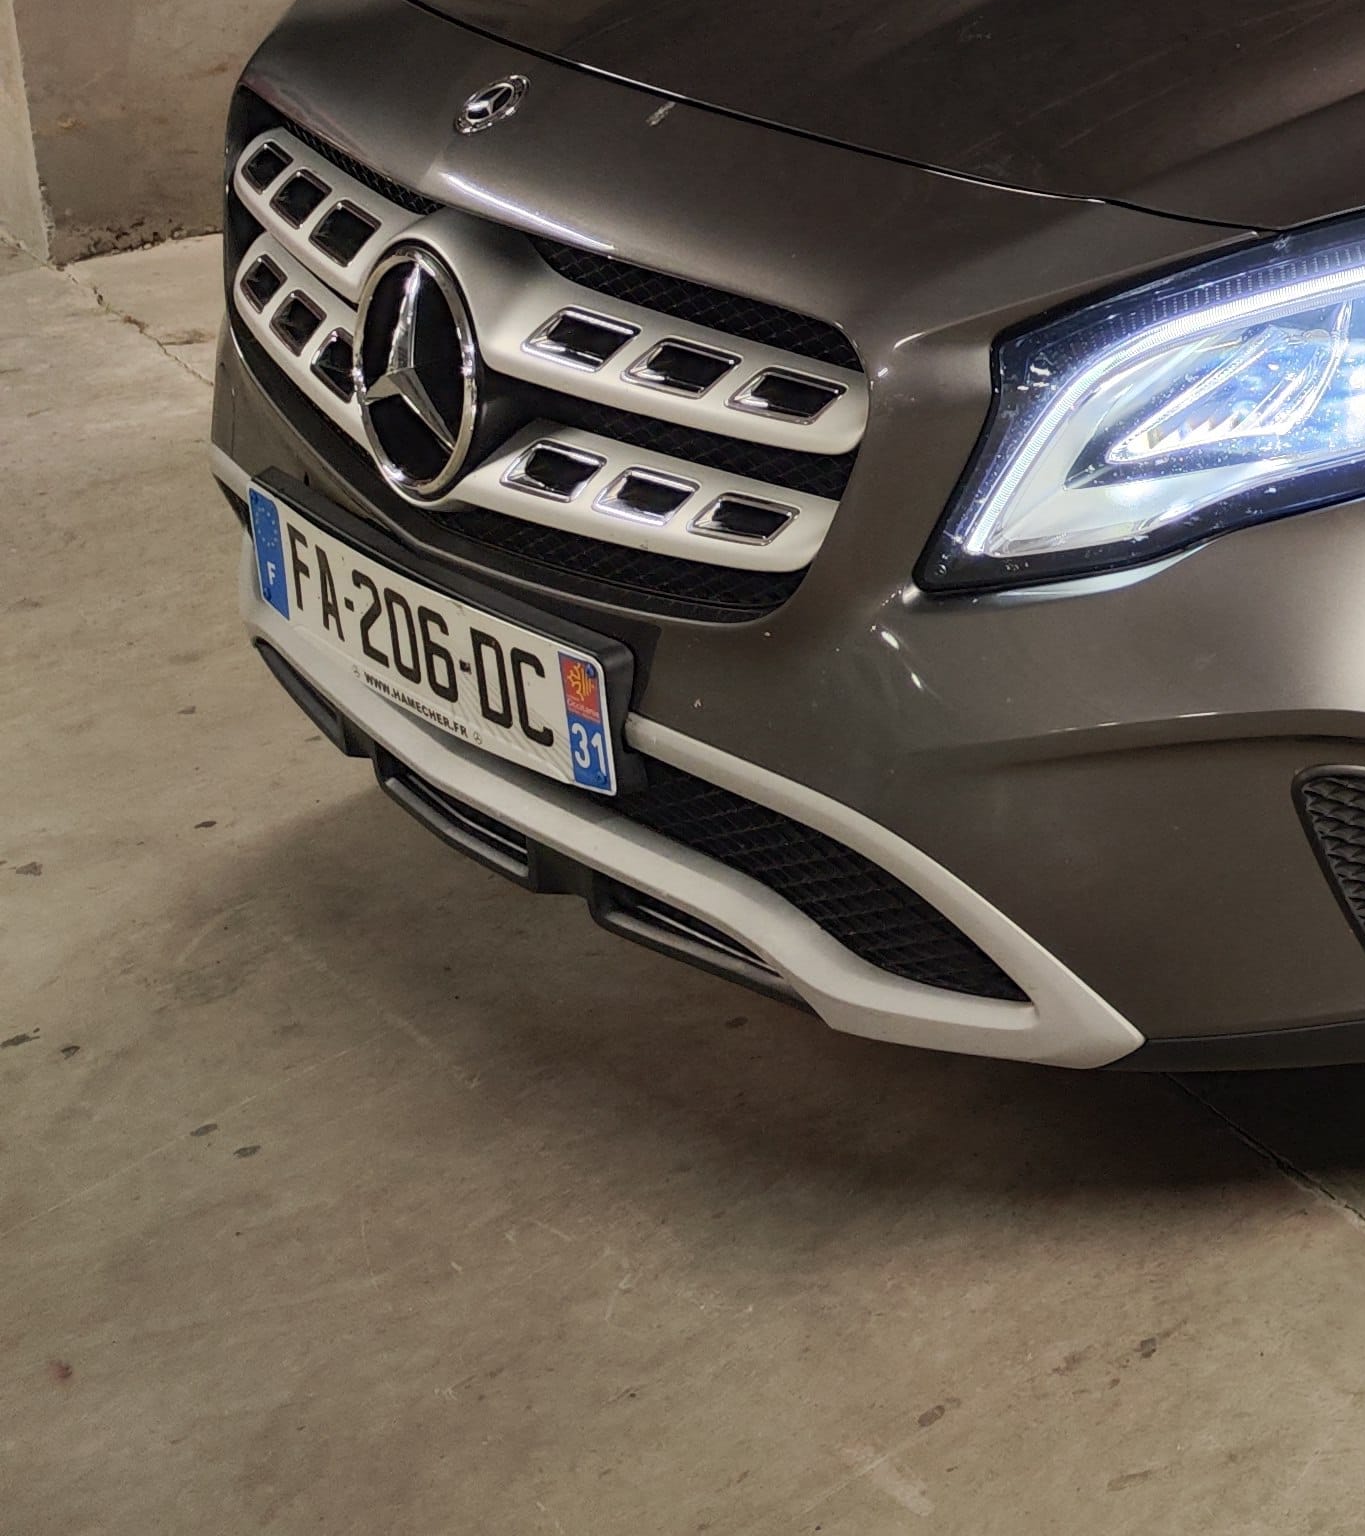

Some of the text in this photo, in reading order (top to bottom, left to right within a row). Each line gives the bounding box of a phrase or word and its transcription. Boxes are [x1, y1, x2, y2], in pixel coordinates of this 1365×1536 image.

[267, 560, 276, 586] F
[286, 522, 554, 747] FA-206-DC
[363, 671, 469, 739] WWW.HAMECHER.FR
[571, 722, 607, 777] 31
